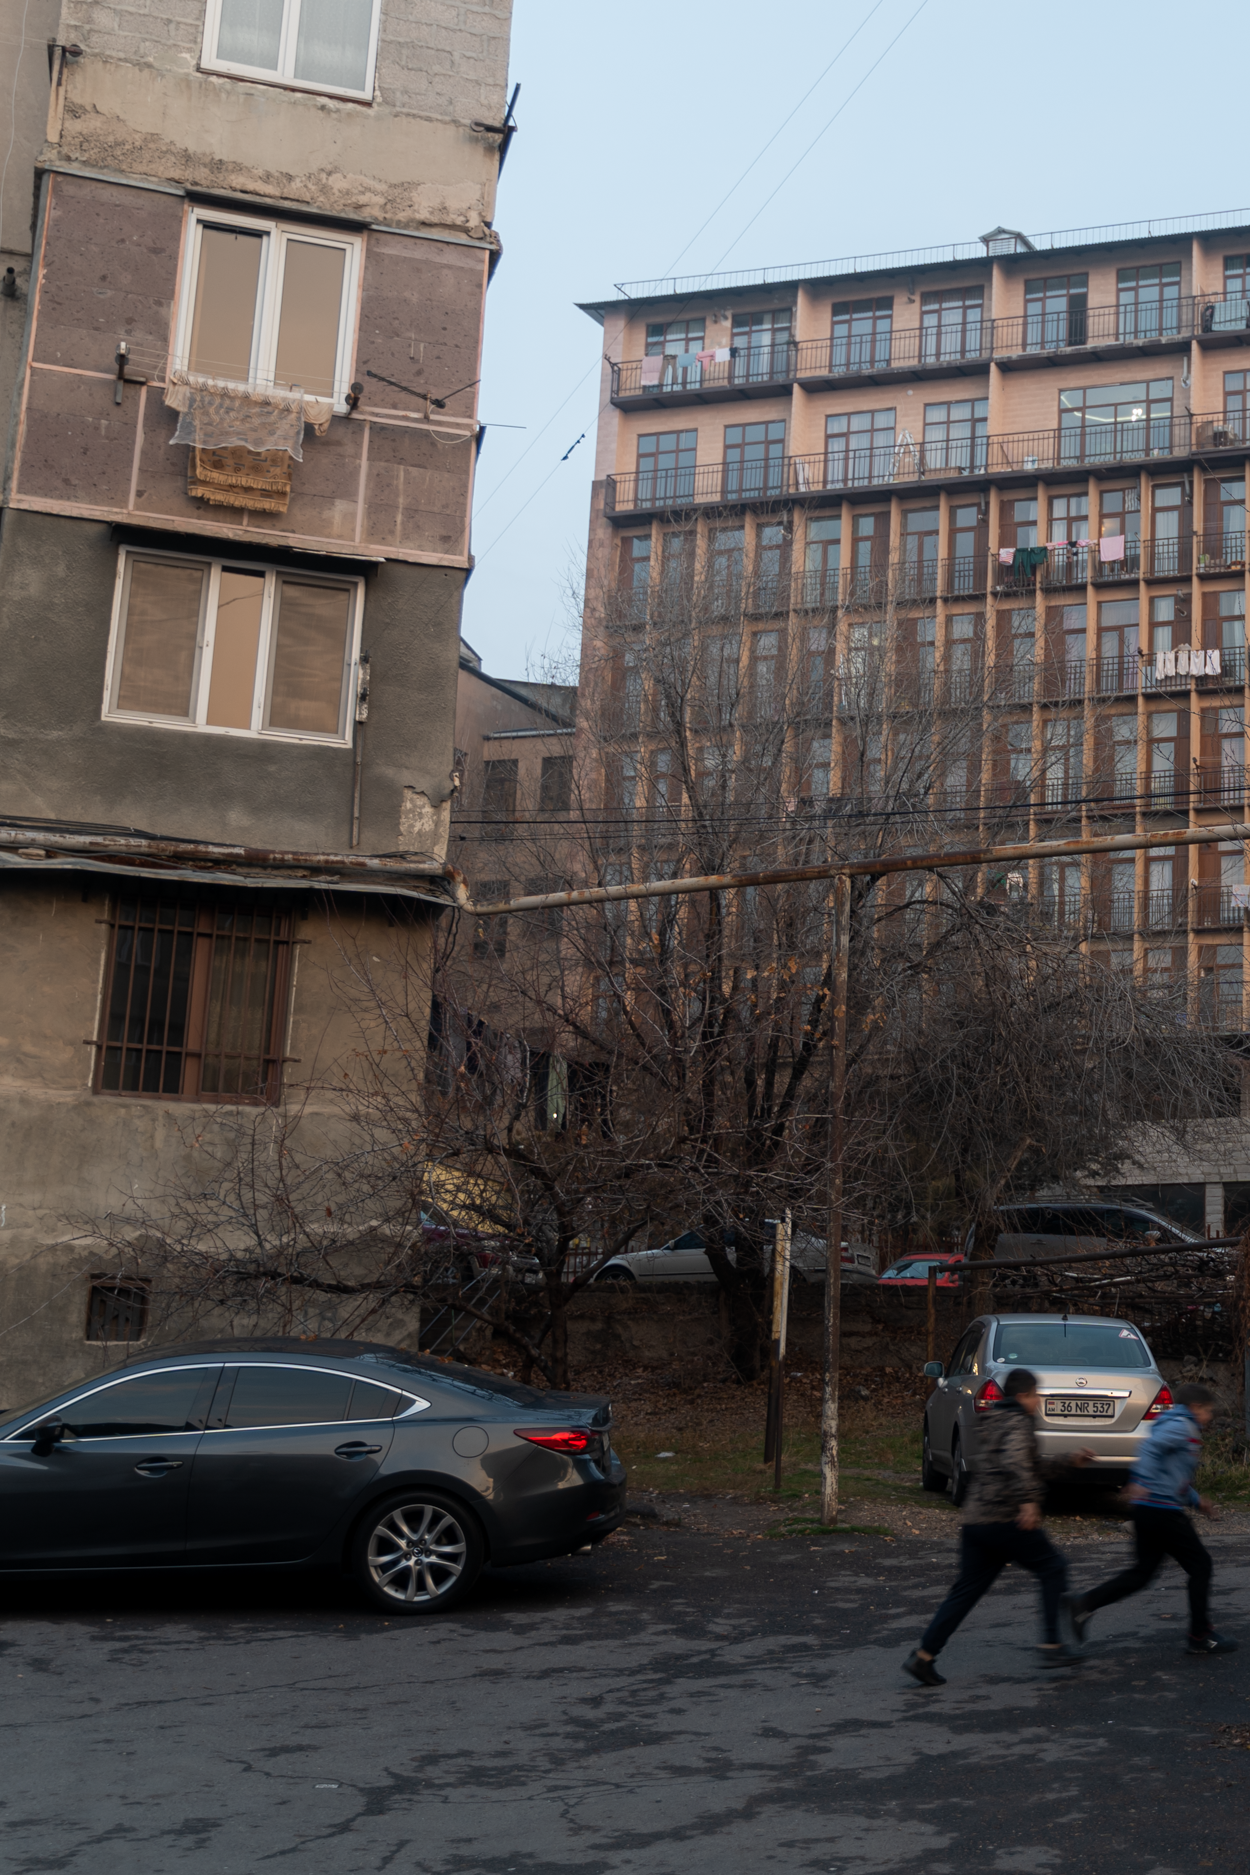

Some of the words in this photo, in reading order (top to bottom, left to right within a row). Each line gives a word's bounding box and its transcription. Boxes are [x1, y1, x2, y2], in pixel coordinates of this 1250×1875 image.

[1060, 1401, 1072, 1413] 36
[1075, 1402, 1089, 1413] NR
[1093, 1402, 1111, 1413] 537
